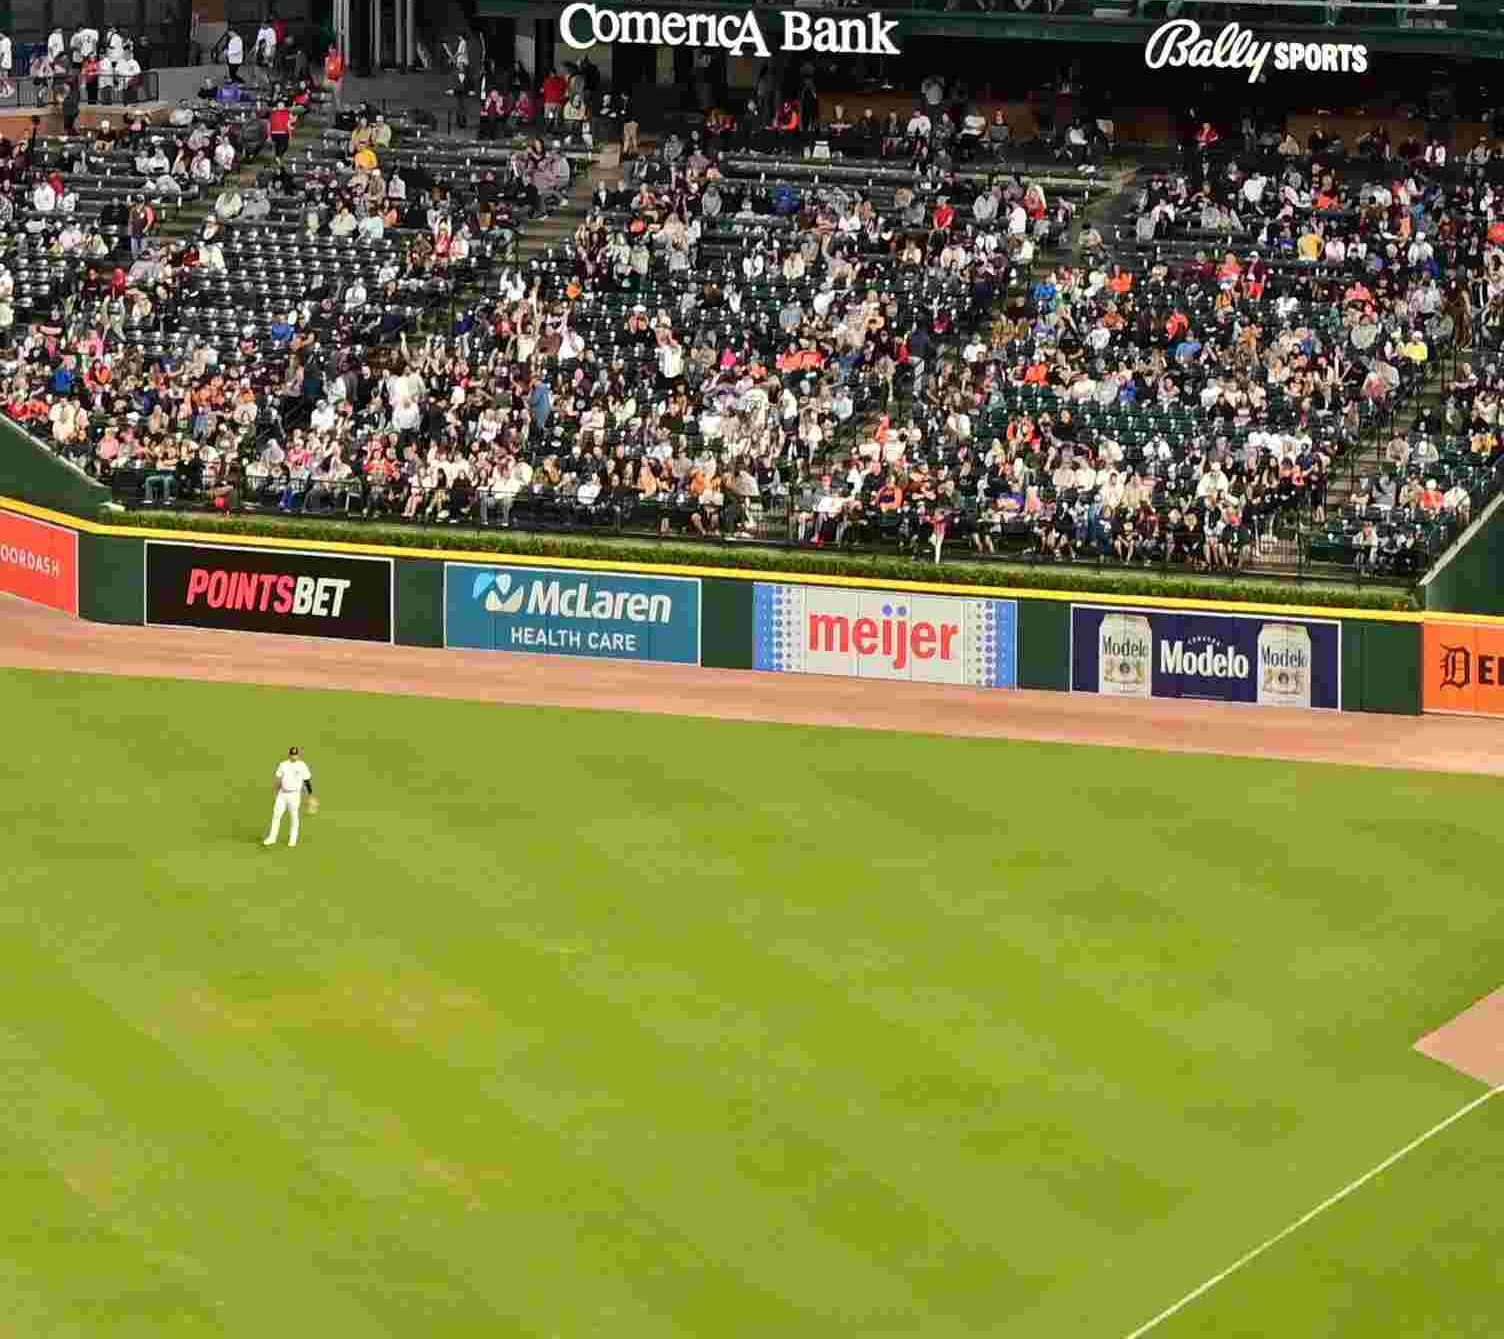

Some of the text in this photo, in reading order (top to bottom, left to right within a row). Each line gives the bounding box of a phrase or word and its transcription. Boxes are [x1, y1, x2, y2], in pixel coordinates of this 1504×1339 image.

[781, 10, 901, 57] Bank
[1144, 18, 1368, 84] Bally SPORTS
[186, 568, 351, 619] POINTSBET
[527, 581, 672, 624] McLaren
[510, 626, 637, 653] HEALTH CARE
[808, 604, 960, 670] meijer
[1159, 639, 1249, 679] Modelo
